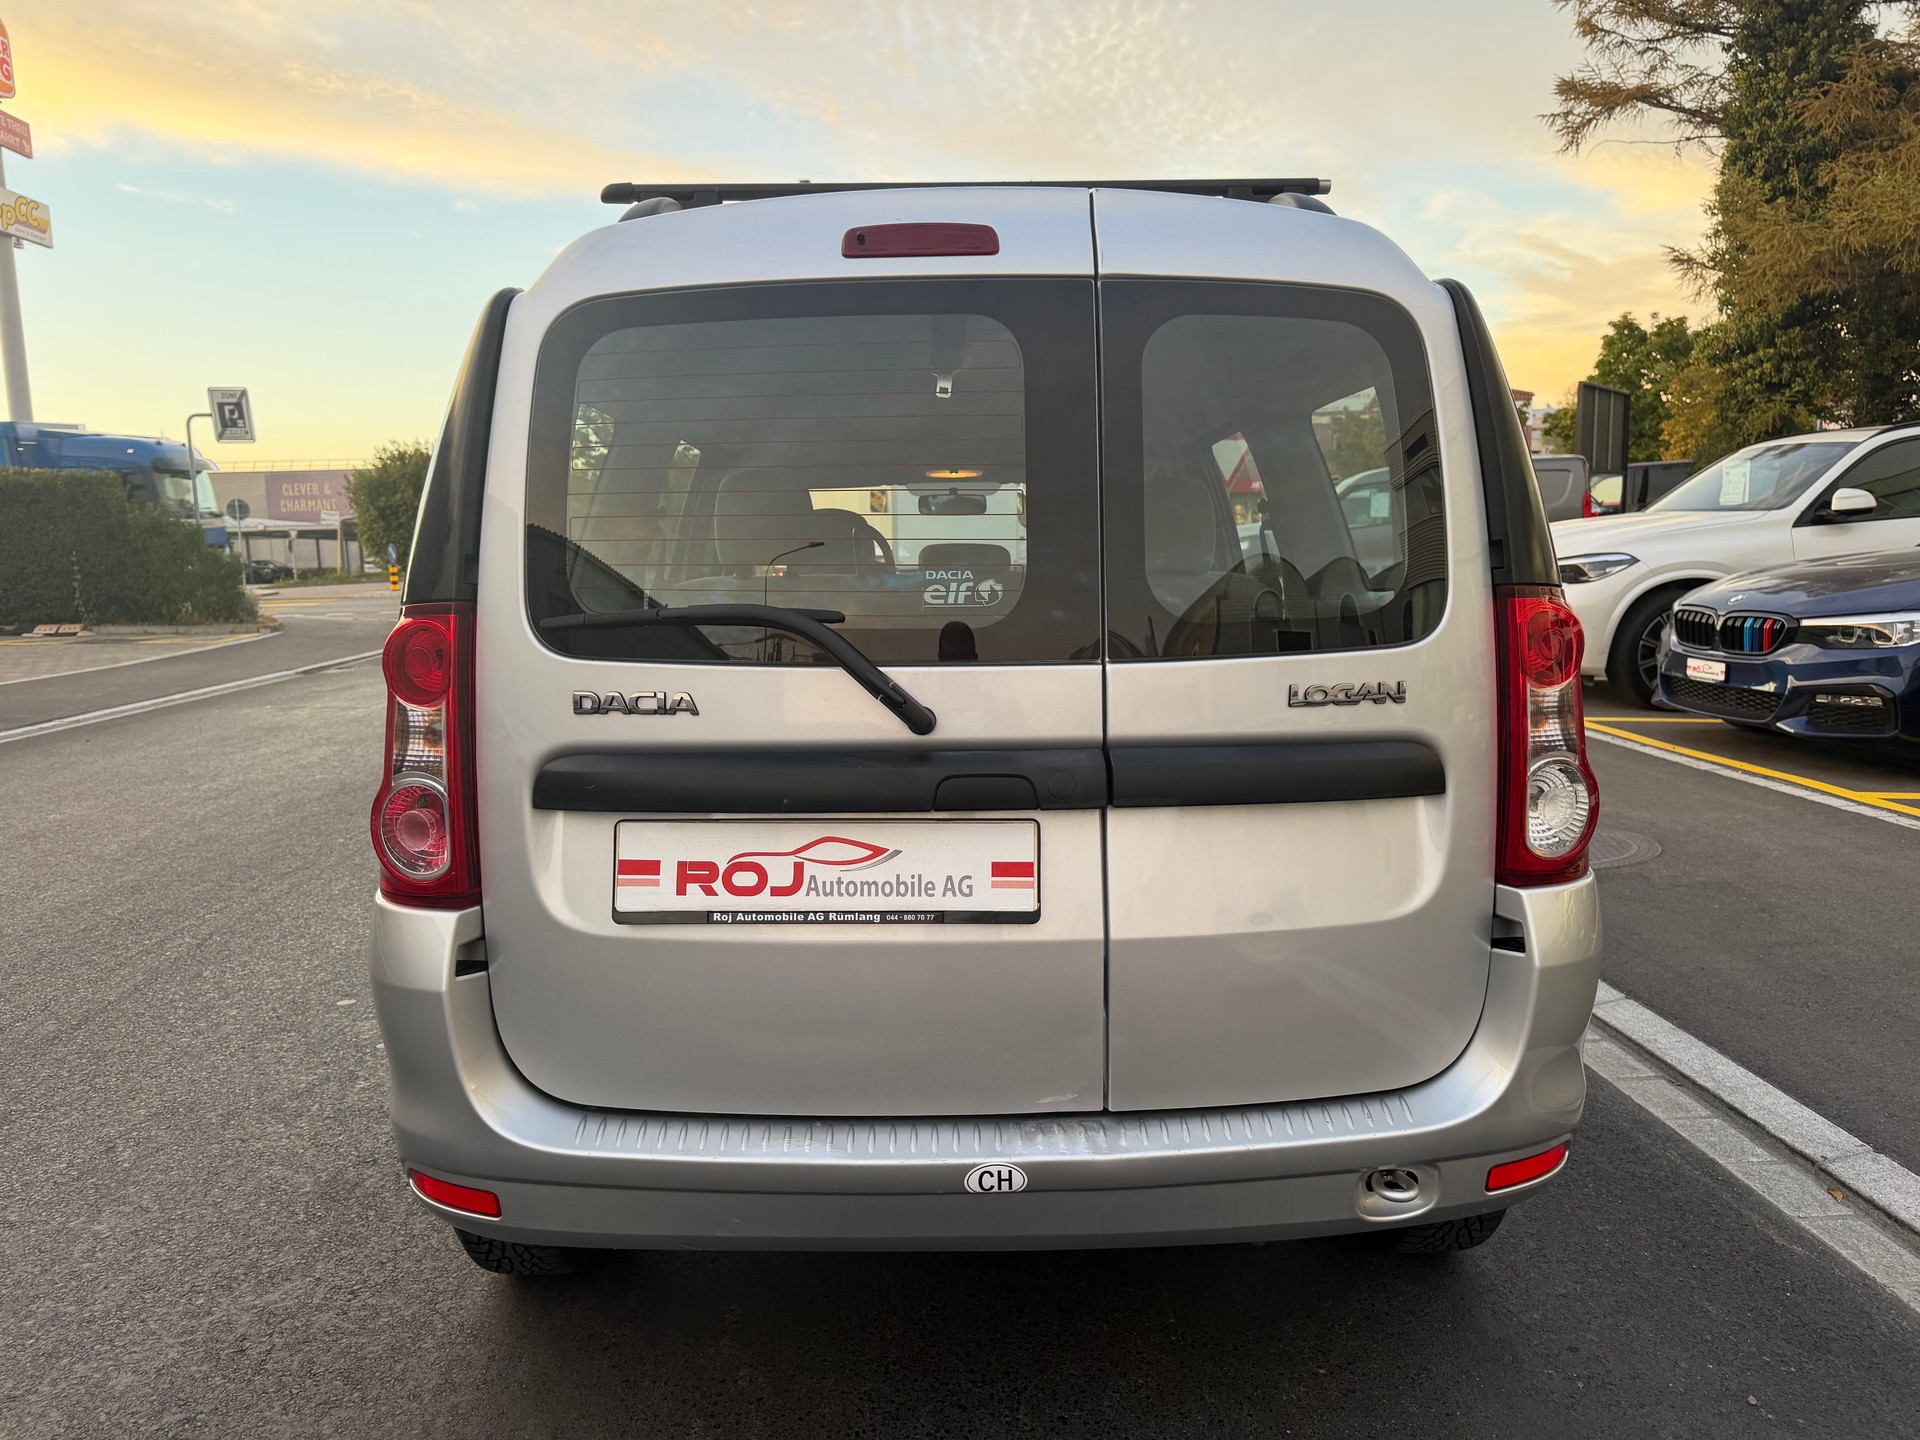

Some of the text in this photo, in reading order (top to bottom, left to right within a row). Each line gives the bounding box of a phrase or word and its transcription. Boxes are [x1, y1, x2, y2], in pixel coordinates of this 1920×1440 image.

[0, 195, 40, 231] pCC
[282, 482, 332, 496] CLEVER &
[280, 498, 337, 512] CHARMANT
[925, 570, 974, 579] DACIA
[923, 582, 974, 604] elf
[572, 690, 700, 716] DACIA
[1288, 680, 1407, 708] LOGAN
[675, 861, 974, 898] ROJ Automobile AG
[713, 912, 732, 923] Roj
[736, 912, 804, 921] Automobile
[807, 912, 825, 921] AG
[829, 911, 881, 923] Rümlang
[978, 1169, 1013, 1192] CH
